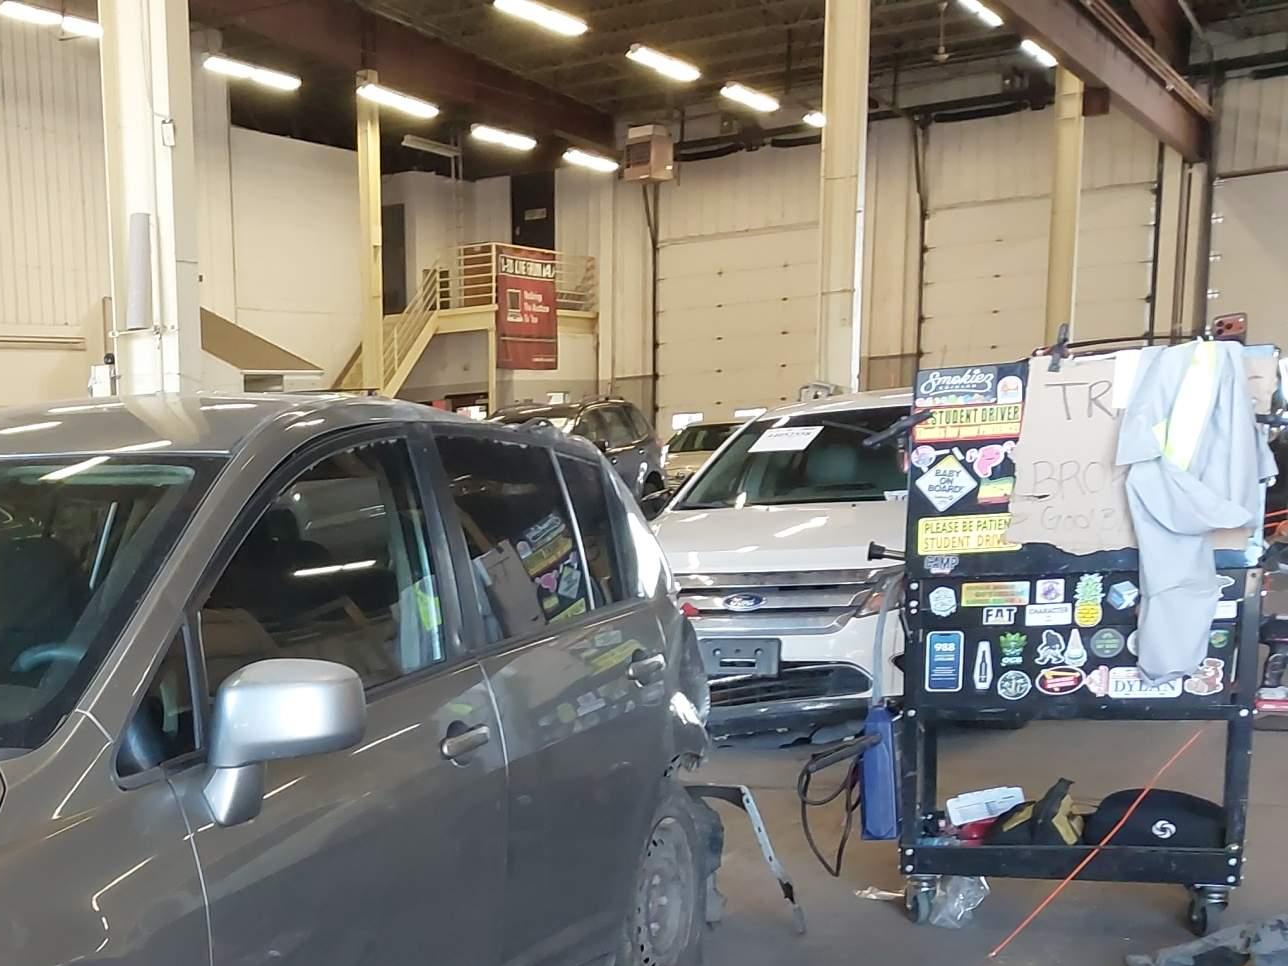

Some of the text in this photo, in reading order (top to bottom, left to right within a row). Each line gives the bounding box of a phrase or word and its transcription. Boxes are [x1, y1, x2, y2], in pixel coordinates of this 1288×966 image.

[1044, 380, 1124, 421] TR
[931, 405, 1021, 425] STUDENT DRIVER
[934, 469, 963, 478] BABY
[939, 477, 954, 486] ON
[924, 518, 1012, 535] PLEASE BE PATIEN
[923, 535, 971, 550] STUDENT
[985, 608, 1016, 624] FAT
